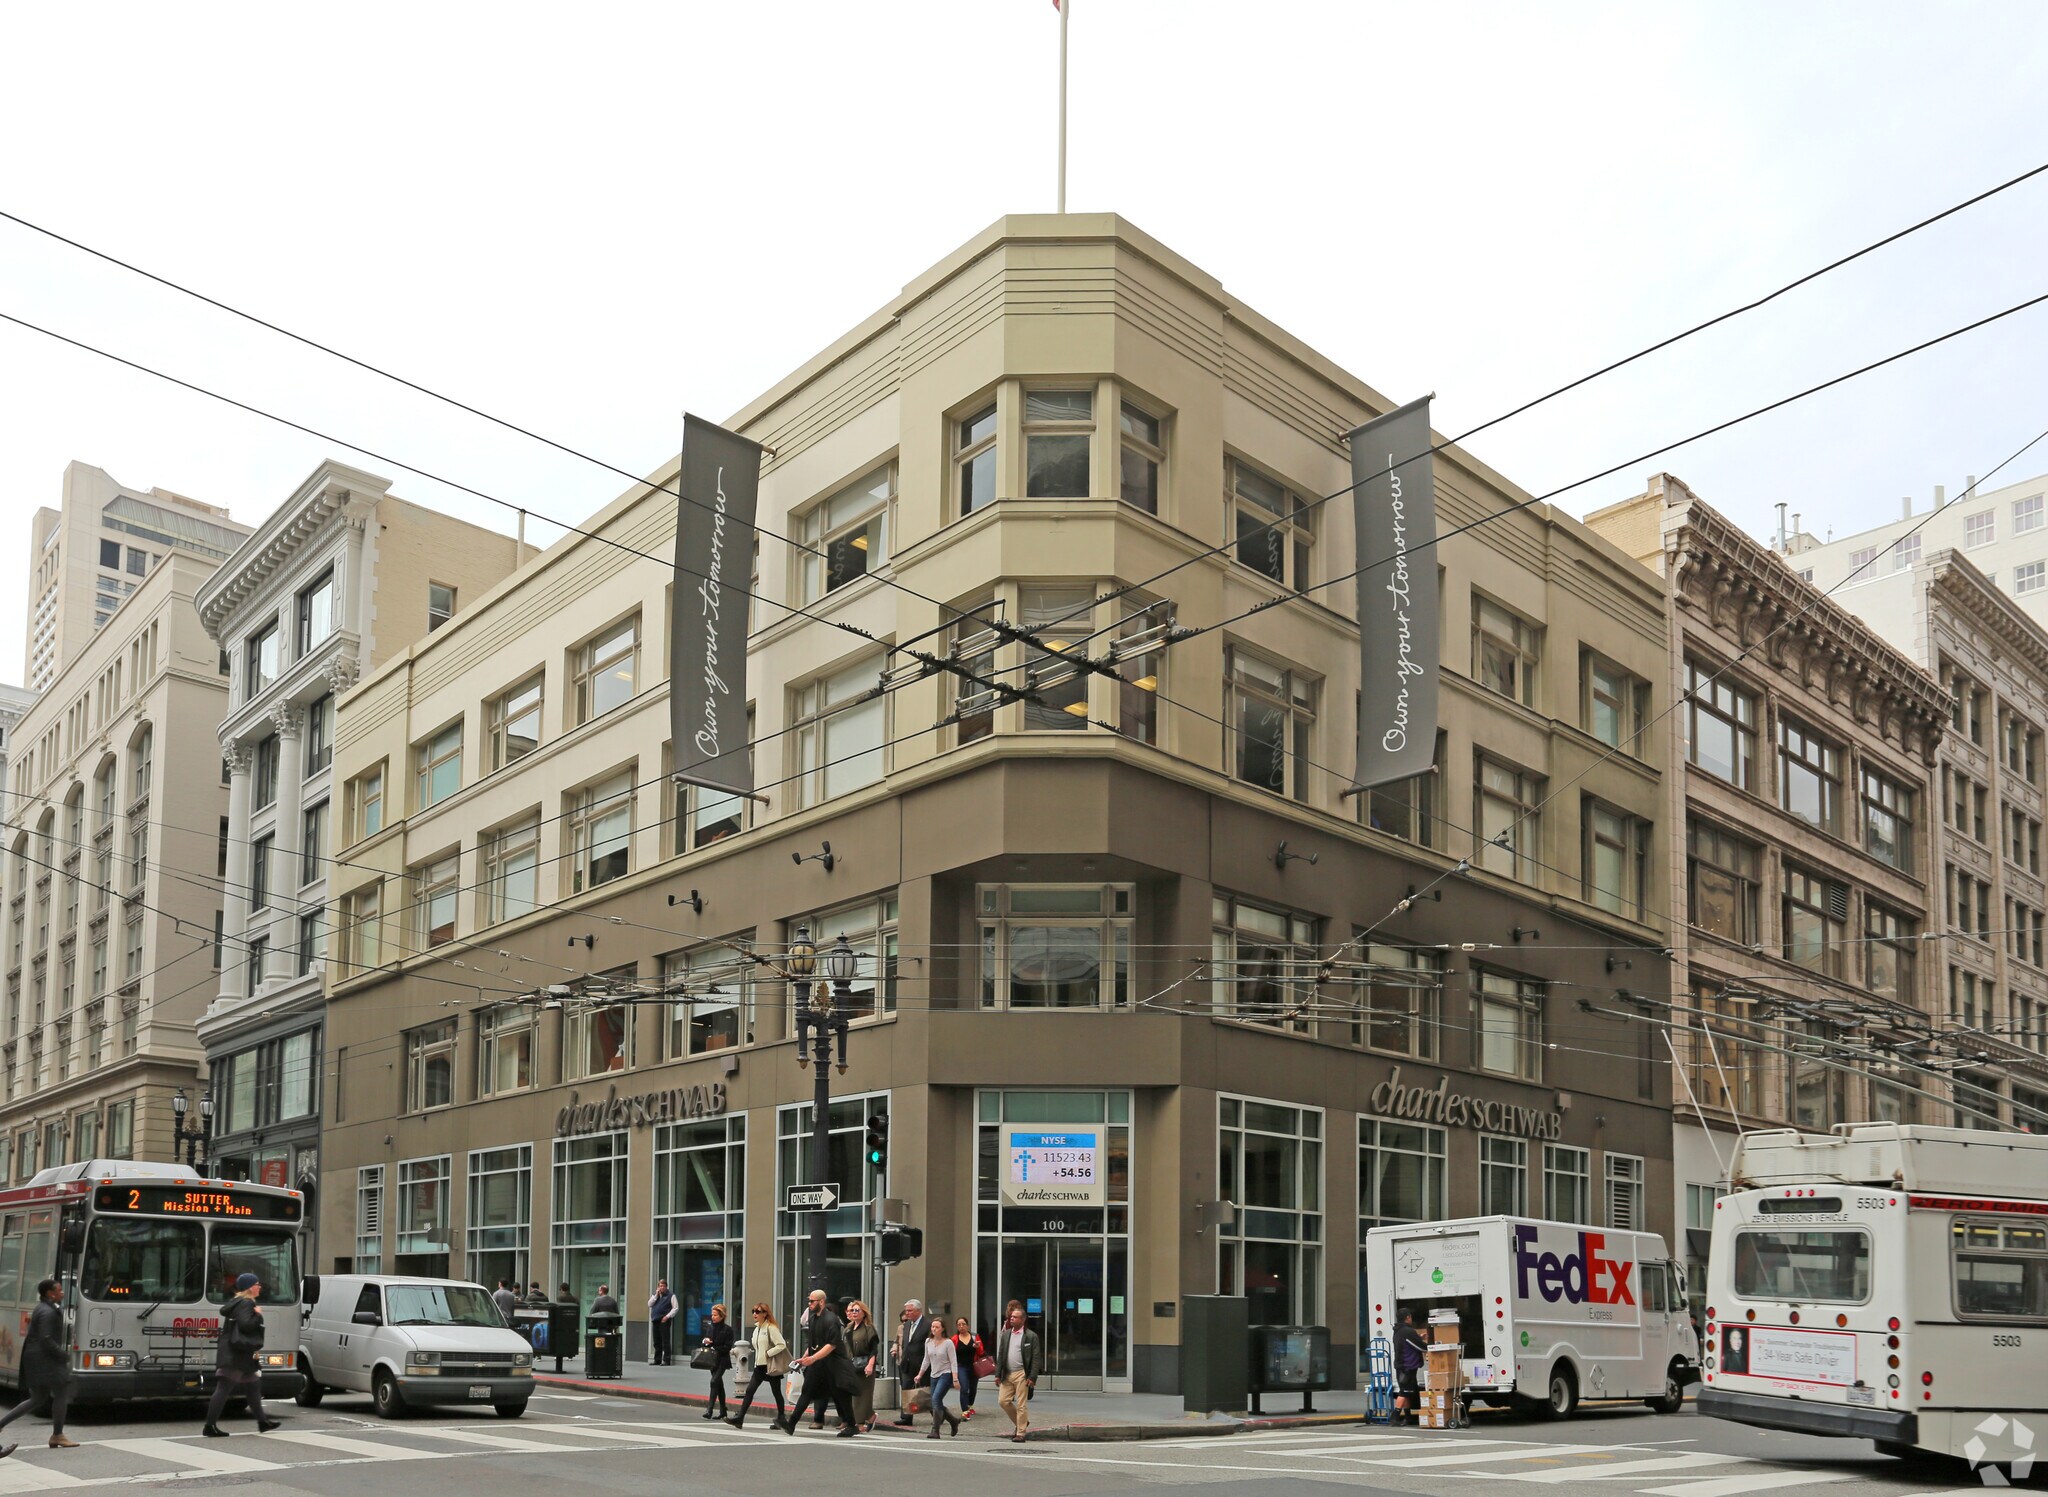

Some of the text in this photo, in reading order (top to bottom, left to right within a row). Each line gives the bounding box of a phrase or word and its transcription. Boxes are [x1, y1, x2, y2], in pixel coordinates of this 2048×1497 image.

[1382, 453, 1425, 754] Own your tomorrow
[694, 466, 730, 758] Own your tomorrow
[1041, 1136, 1067, 1145] NYSE
[1043, 1152, 1092, 1163] 11523.43
[1052, 1168, 1092, 1178] +54.56
[128, 1189, 140, 1209] 2
[185, 1193, 230, 1205] SUTTER
[792, 1193, 823, 1204] ONE WAY
[1857, 1197, 1886, 1209] 5503
[1913, 1198, 1985, 1210] ZERO
[163, 1201, 209, 1213] Mission
[225, 1205, 252, 1215] Main
[1751, 1213, 1849, 1223] ZERO EMISSIONS VEHICLE
[1041, 1220, 1065, 1231] 100
[1515, 1224, 1636, 1306] FedEx
[1589, 1307, 1613, 1321] Express
[89, 1338, 123, 1349] 8438
[1993, 1335, 2022, 1347] 5503
[1794, 1352, 1813, 1364] Safe
[1814, 1353, 1839, 1367] Driver
